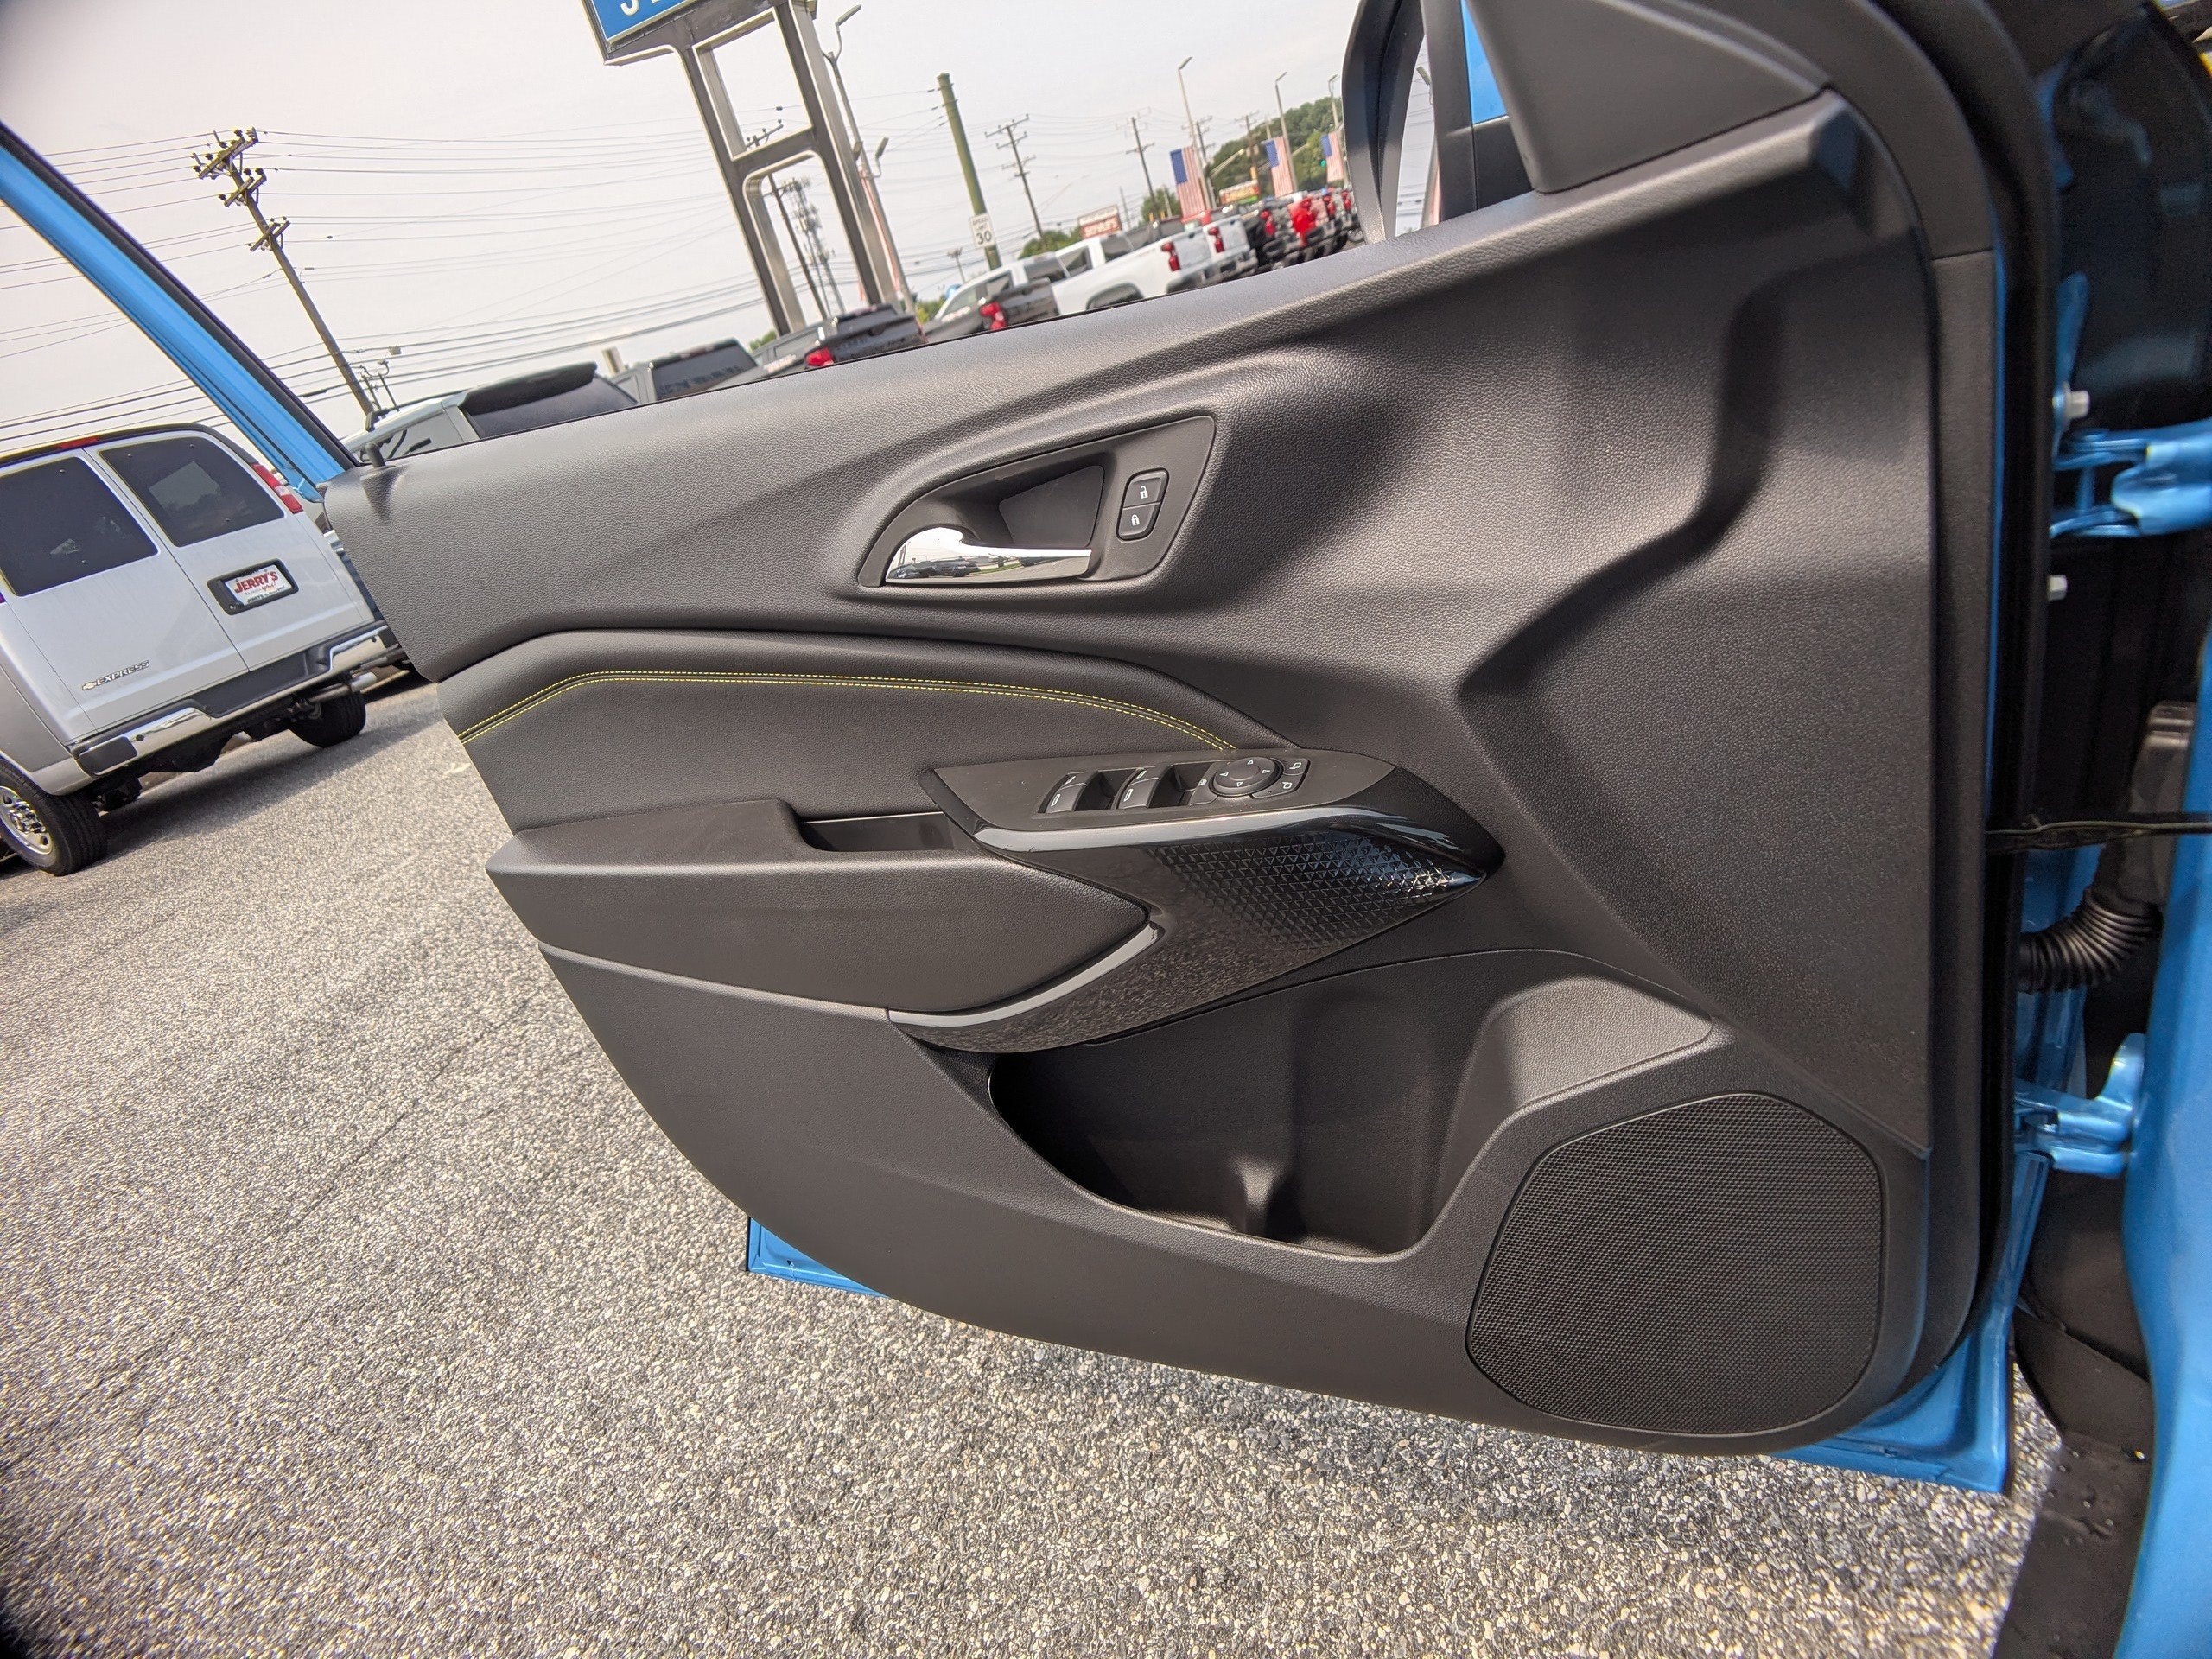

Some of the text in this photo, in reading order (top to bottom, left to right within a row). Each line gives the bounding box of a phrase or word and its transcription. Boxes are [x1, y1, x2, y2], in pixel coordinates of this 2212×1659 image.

[976, 230, 992, 245] 30
[234, 571, 278, 594] JERRY'S
[96, 660, 150, 686] EXPRESS
